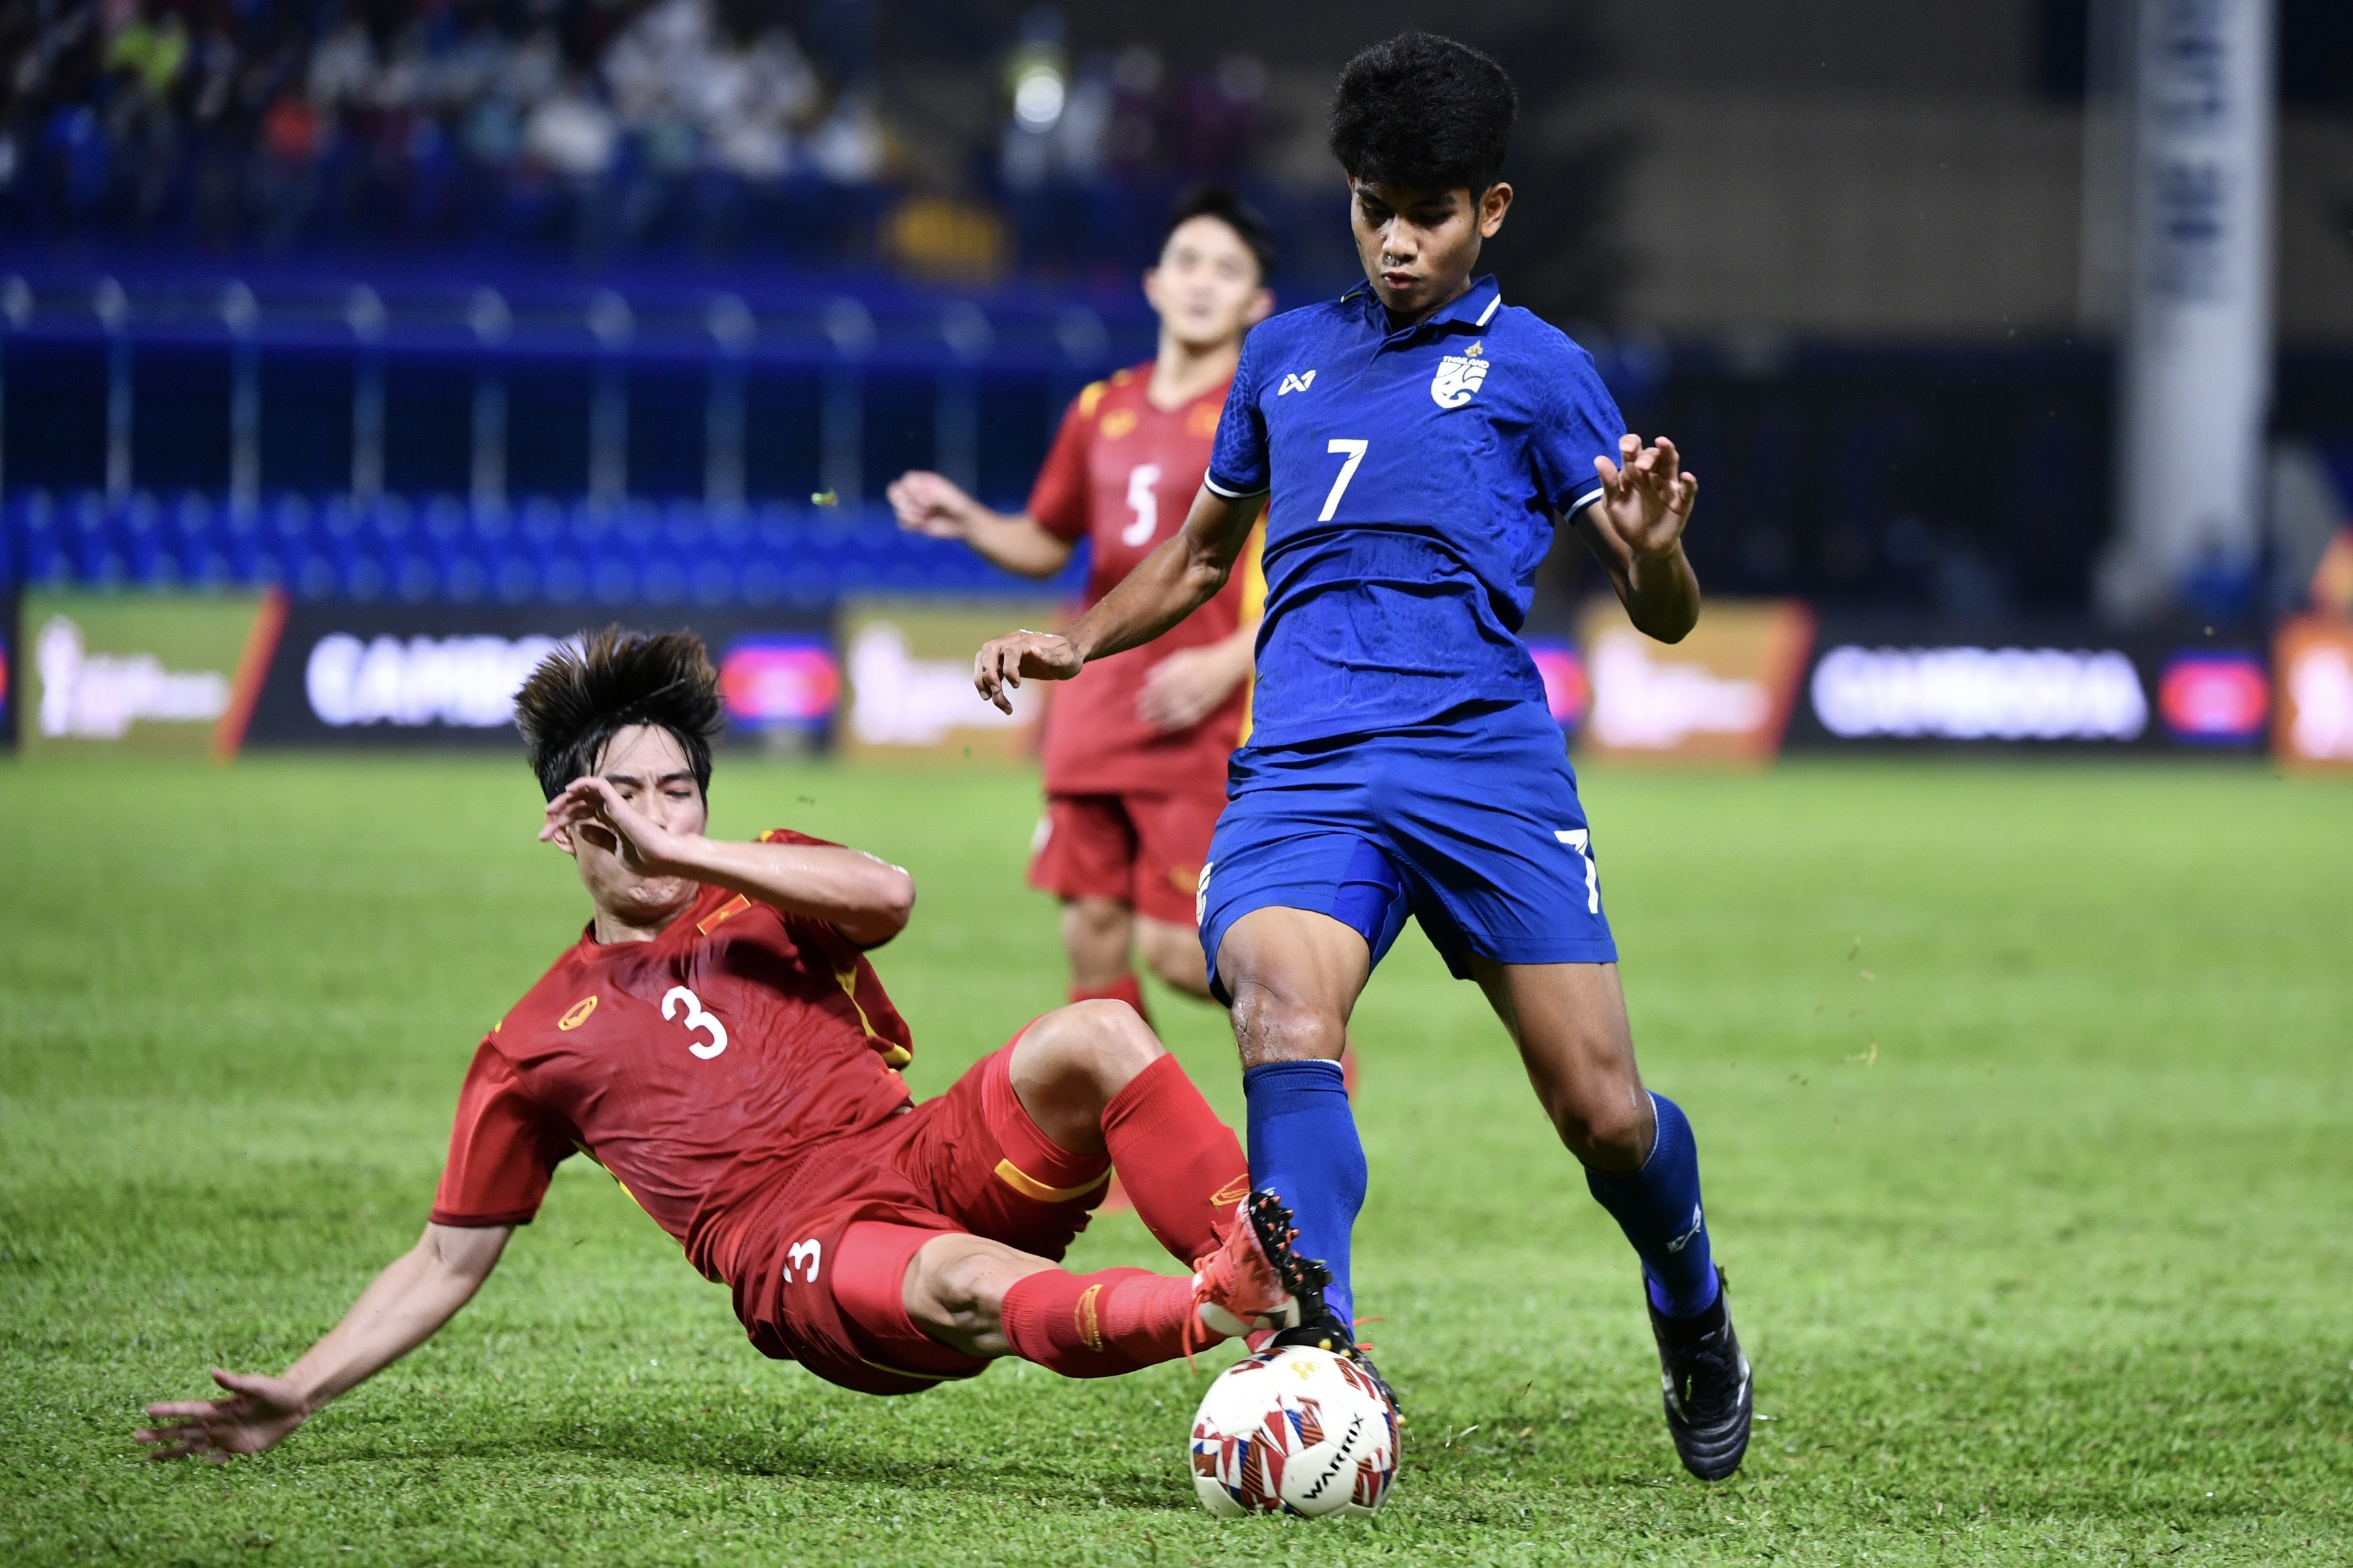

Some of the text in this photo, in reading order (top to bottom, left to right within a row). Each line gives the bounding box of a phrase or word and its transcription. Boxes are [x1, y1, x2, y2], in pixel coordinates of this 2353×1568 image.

[1122, 462, 1162, 546] 5
[1317, 438, 1369, 522] 7
[1553, 829, 1599, 914] 7
[661, 986, 728, 1060] 3
[783, 1238, 821, 1283] 3
